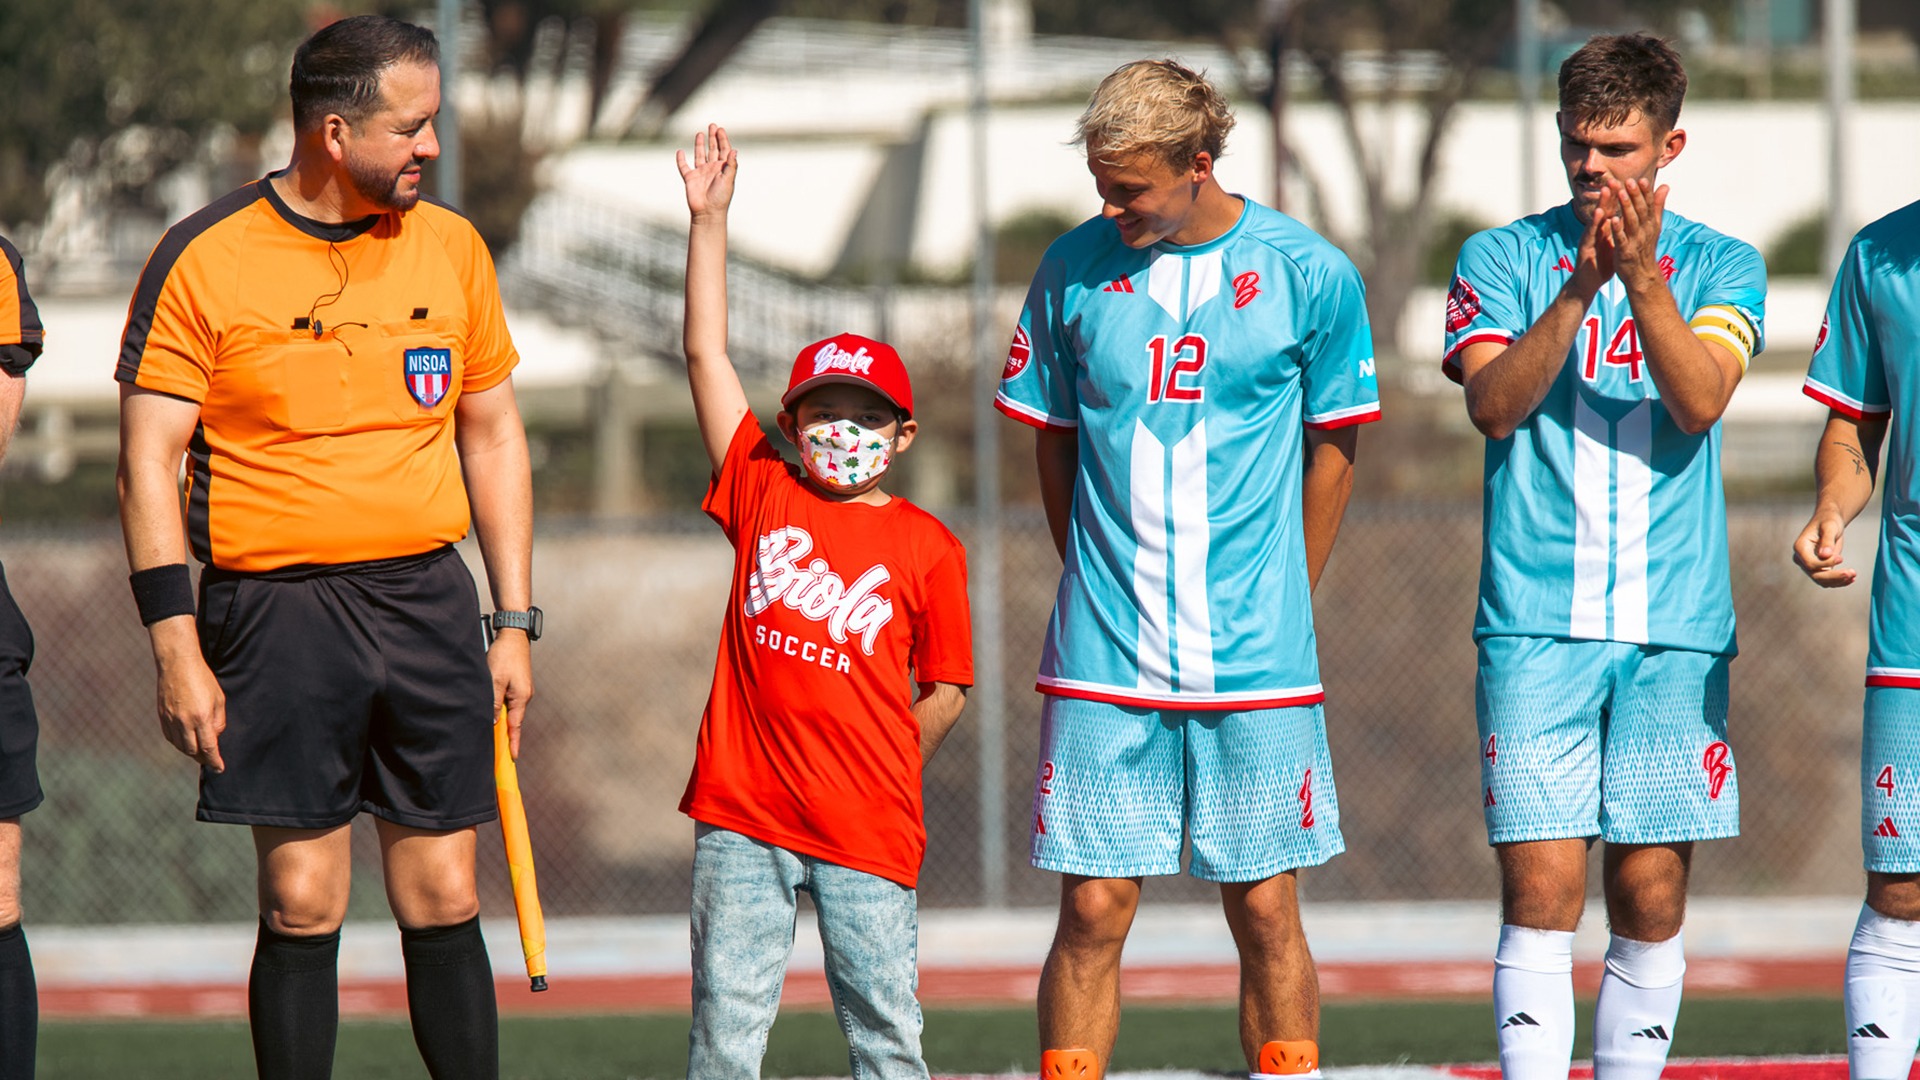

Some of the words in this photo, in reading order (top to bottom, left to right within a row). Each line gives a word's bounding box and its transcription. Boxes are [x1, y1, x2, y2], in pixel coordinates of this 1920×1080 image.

[1232, 270, 1262, 310] B
[408, 354, 448, 372] NISOA
[813, 342, 874, 375] Biola
[1145, 332, 1209, 404] 12
[1581, 314, 1646, 384] 14
[743, 524, 894, 656] Biola
[755, 624, 851, 675] SOCCER
[1703, 741, 1733, 801] B
[1875, 765, 1896, 798] 4
